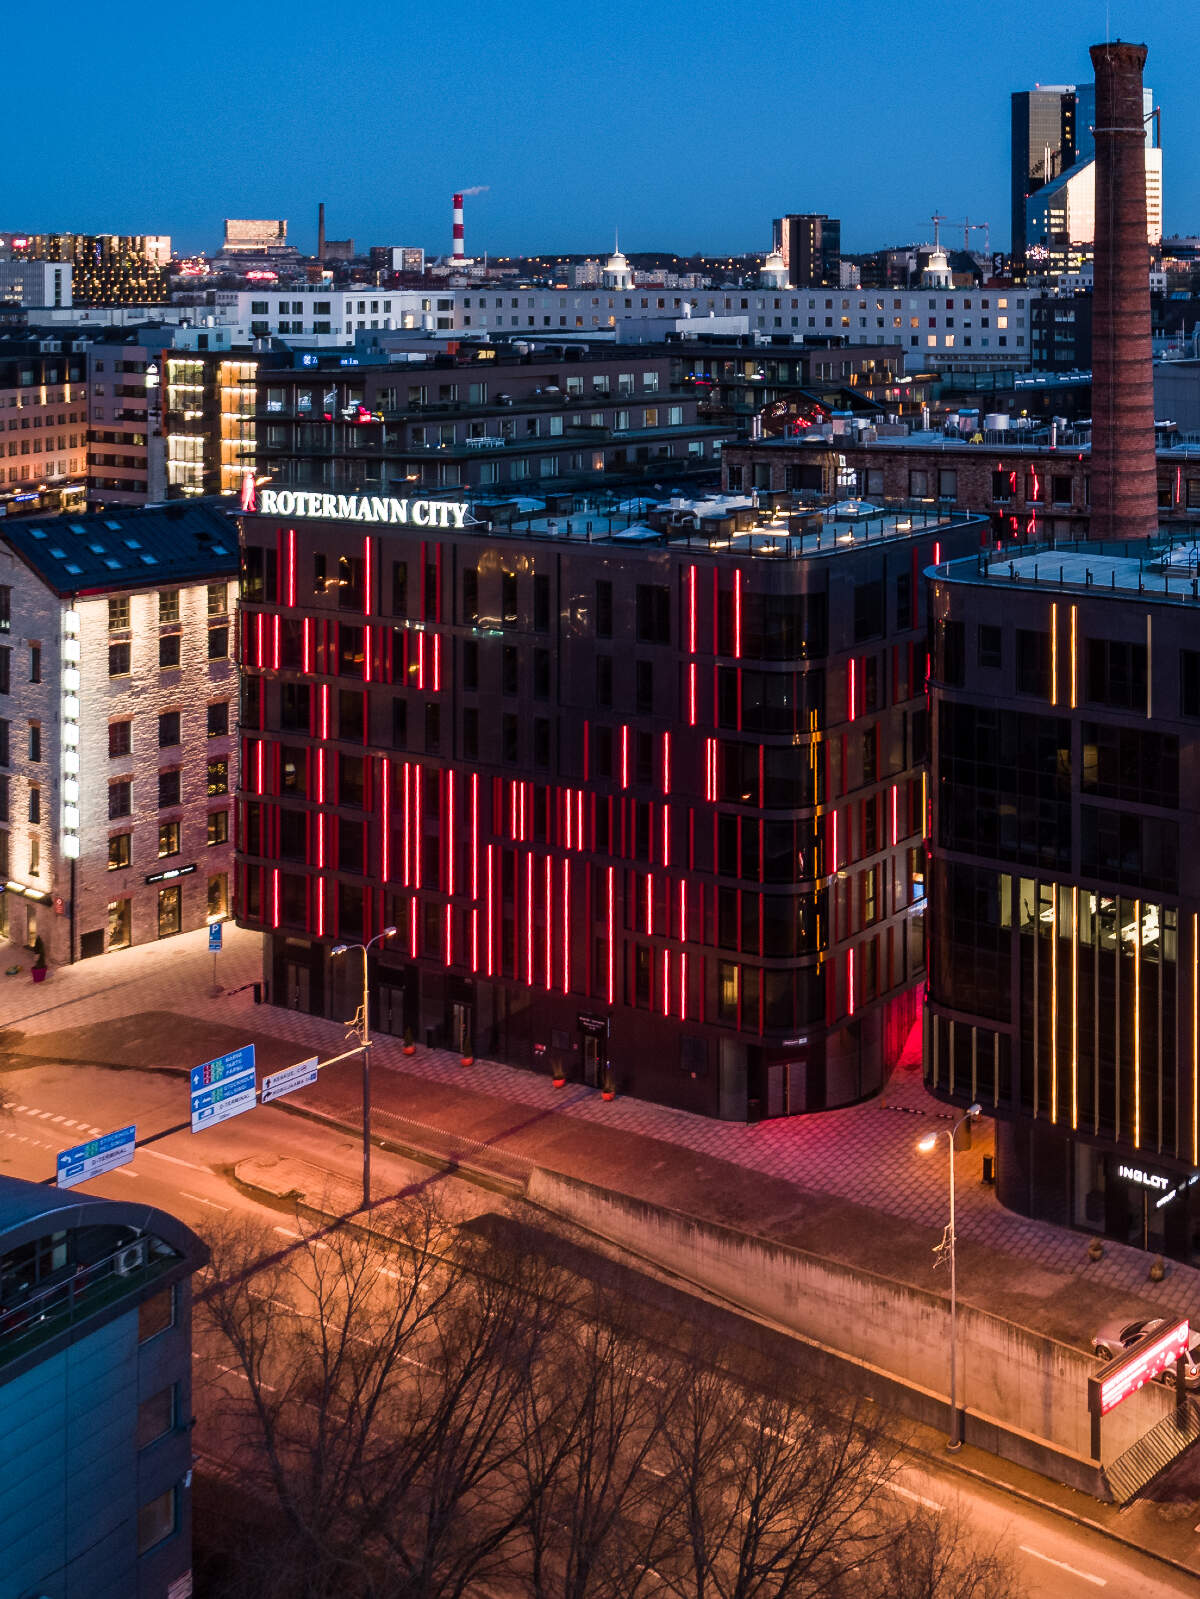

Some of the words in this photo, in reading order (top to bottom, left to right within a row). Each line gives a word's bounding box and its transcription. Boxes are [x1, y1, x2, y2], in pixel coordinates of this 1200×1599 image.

[260, 489, 408, 524] ROTERMANN
[412, 500, 469, 528] CITY
[1118, 1165, 1169, 1190] INGLOT
